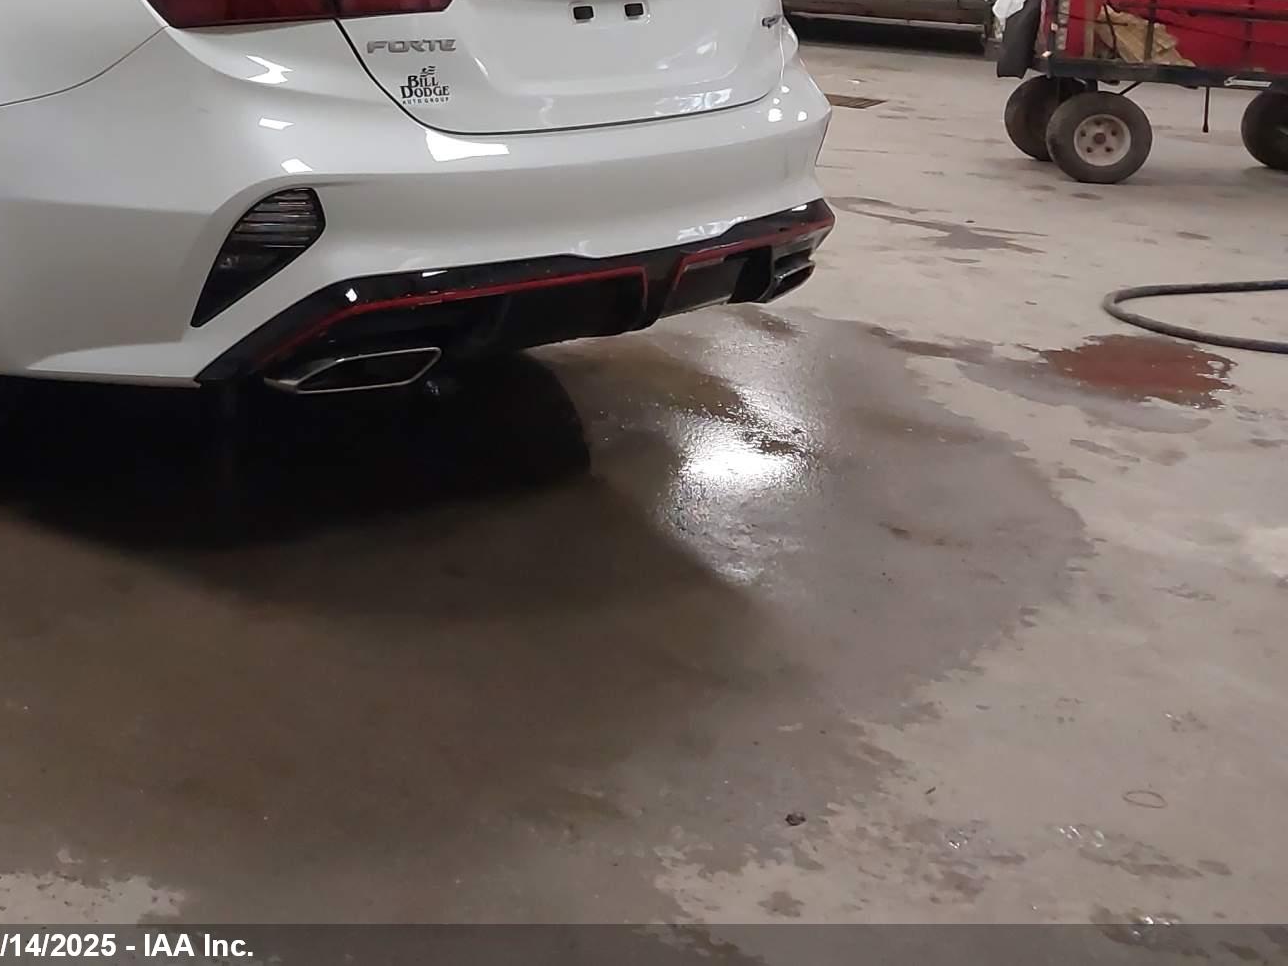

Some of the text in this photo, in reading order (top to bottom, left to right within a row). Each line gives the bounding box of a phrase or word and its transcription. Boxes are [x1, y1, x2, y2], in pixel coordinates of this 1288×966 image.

[367, 39, 456, 53] FORTE
[407, 75, 439, 88] BILL
[400, 86, 450, 98] DODGE
